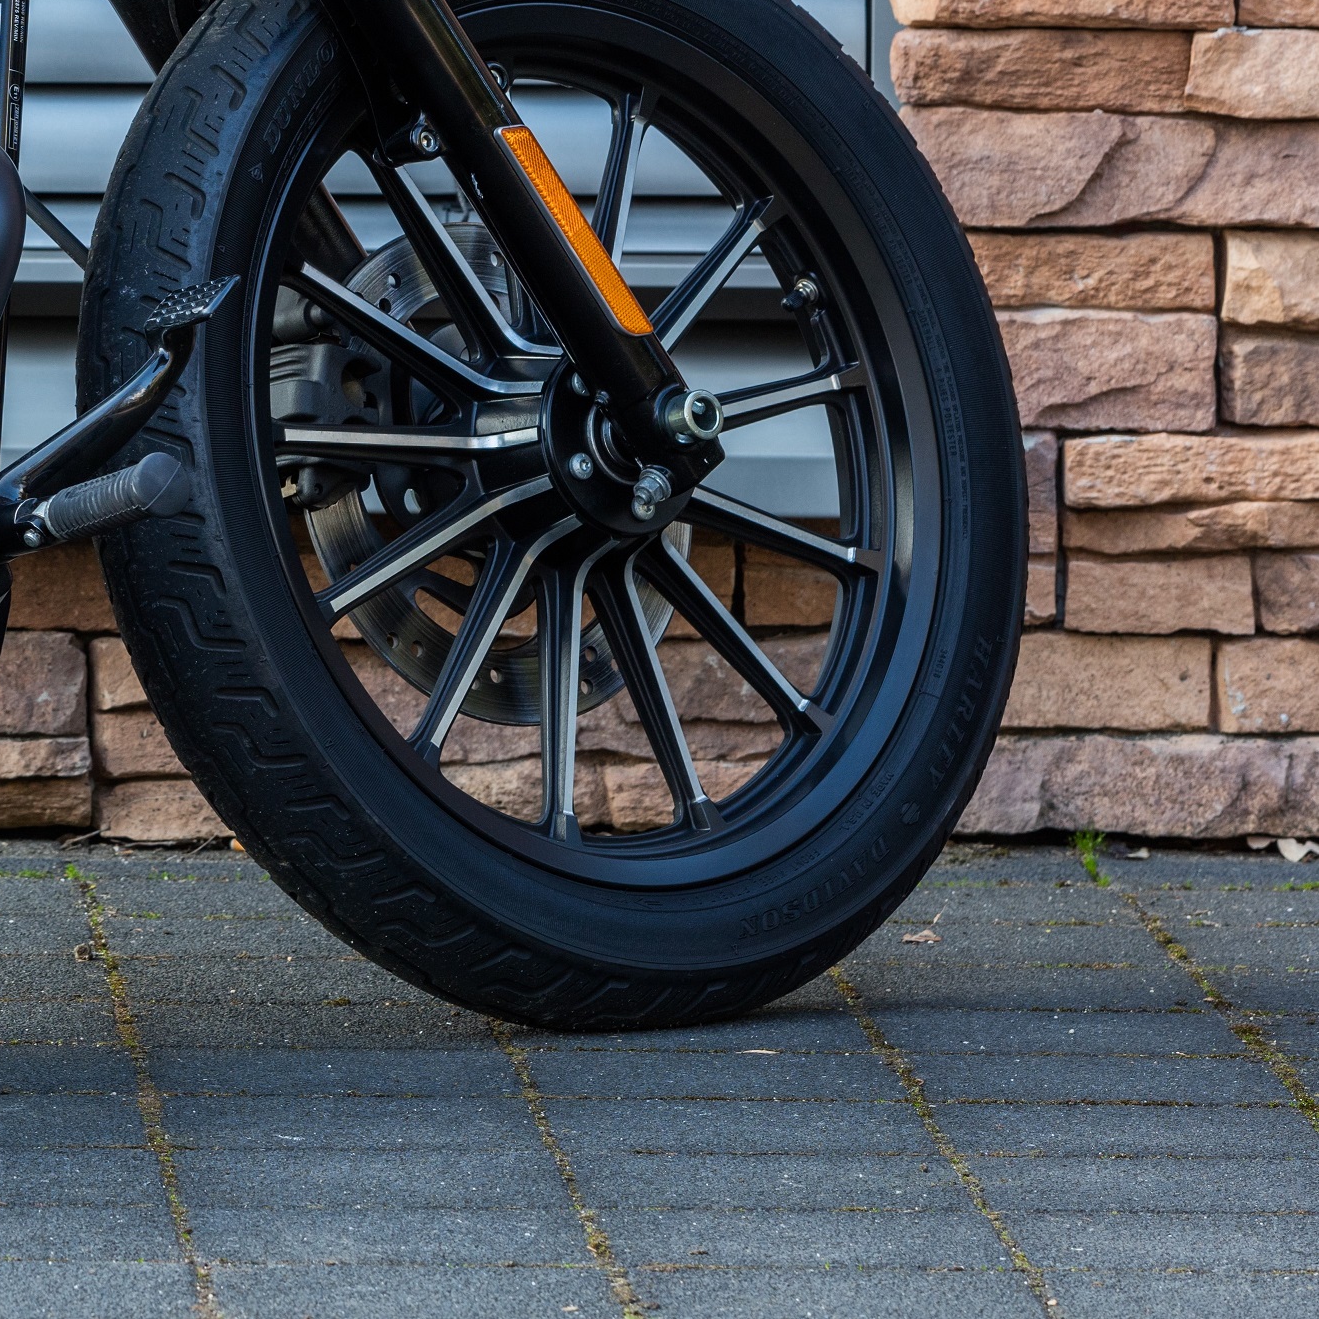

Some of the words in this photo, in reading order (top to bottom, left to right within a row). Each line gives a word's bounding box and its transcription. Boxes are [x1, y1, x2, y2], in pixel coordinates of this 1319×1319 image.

[263, 33, 339, 155] DUNLO
[937, 377, 948, 402] PLIES
[943, 407, 957, 456] POLYESTER
[930, 634, 994, 790] HARLEY
[860, 797, 872, 809] IN
[870, 769, 894, 798] MADE
[738, 833, 891, 939] DAVIDSON
[788, 846, 820, 871] FRONT
